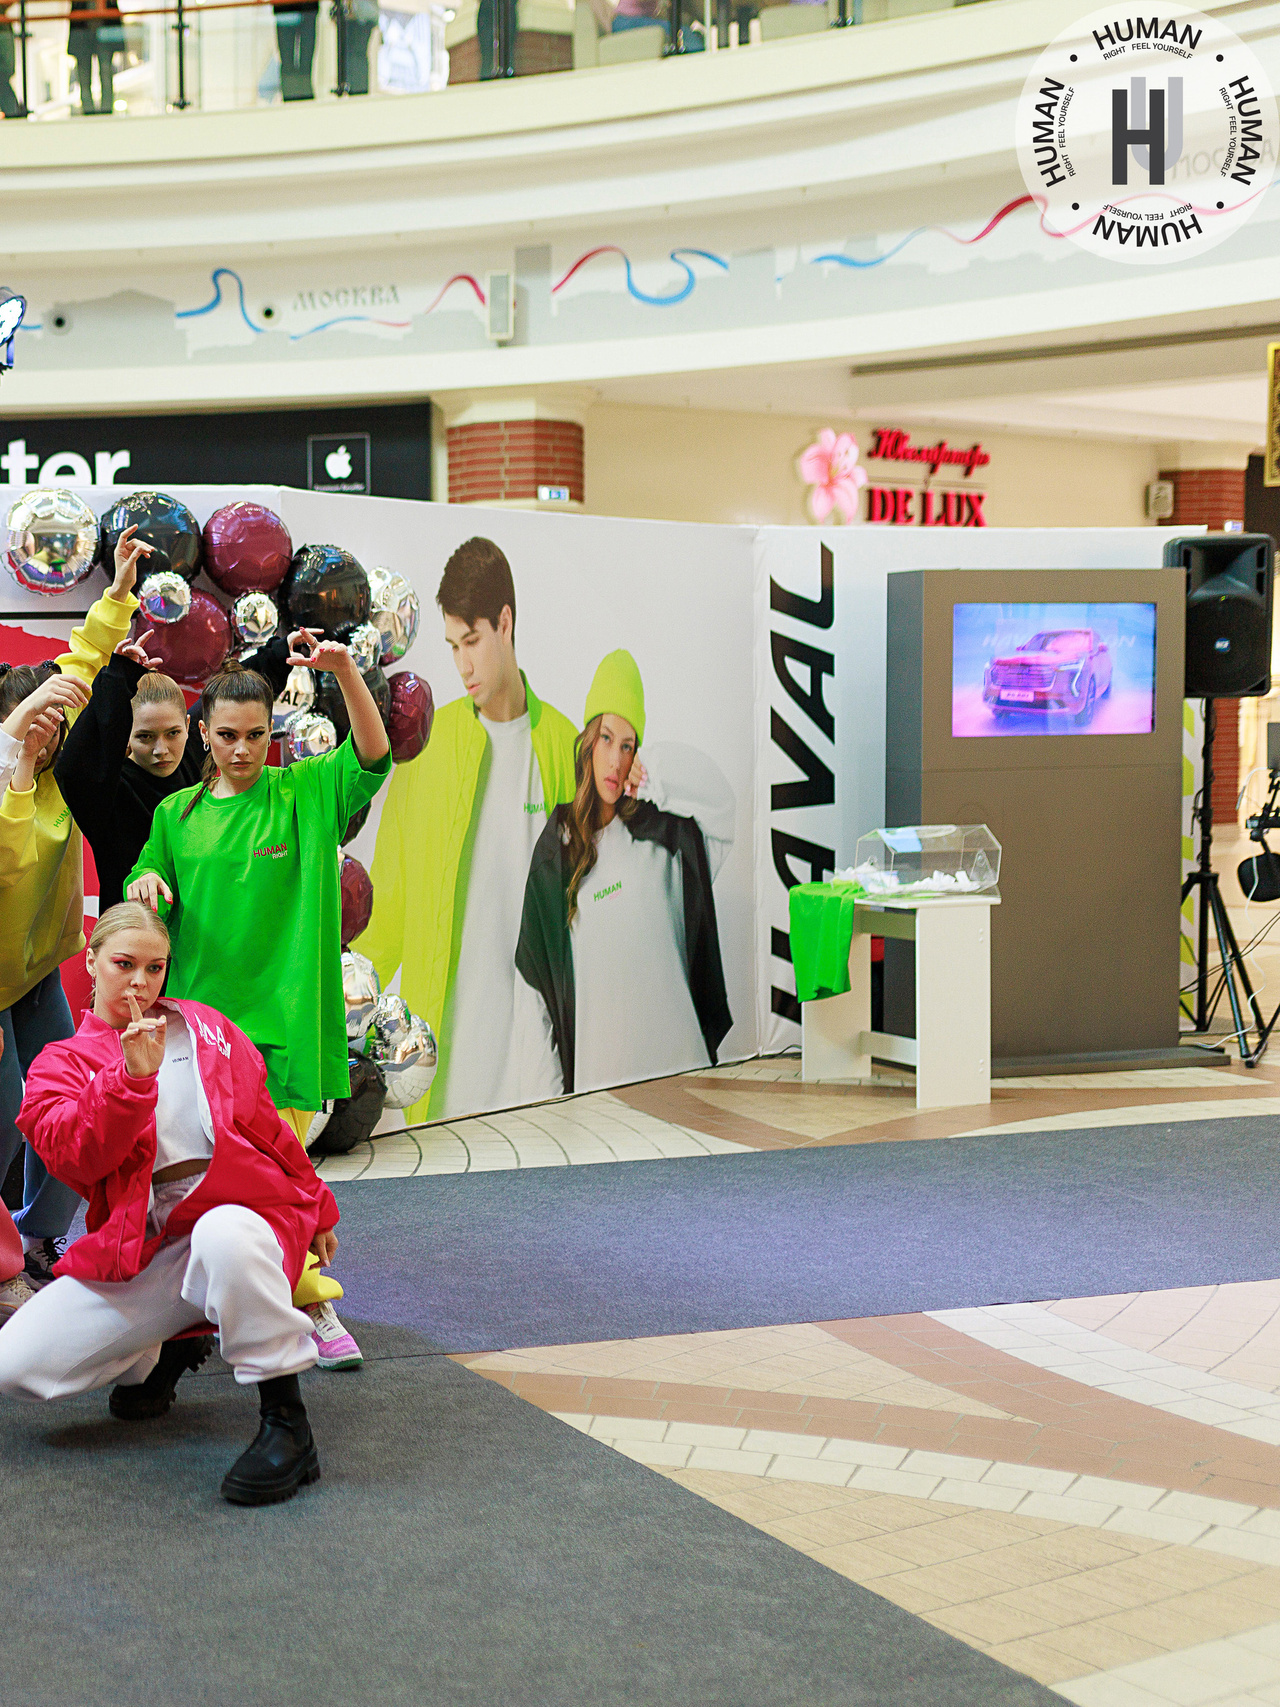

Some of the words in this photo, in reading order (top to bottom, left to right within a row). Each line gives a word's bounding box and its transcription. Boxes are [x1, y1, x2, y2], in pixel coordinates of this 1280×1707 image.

[867, 487, 915, 525] DE
[920, 489, 987, 527] LUX
[253, 842, 288, 858] HUMAN
[593, 880, 622, 902] HUMAN
